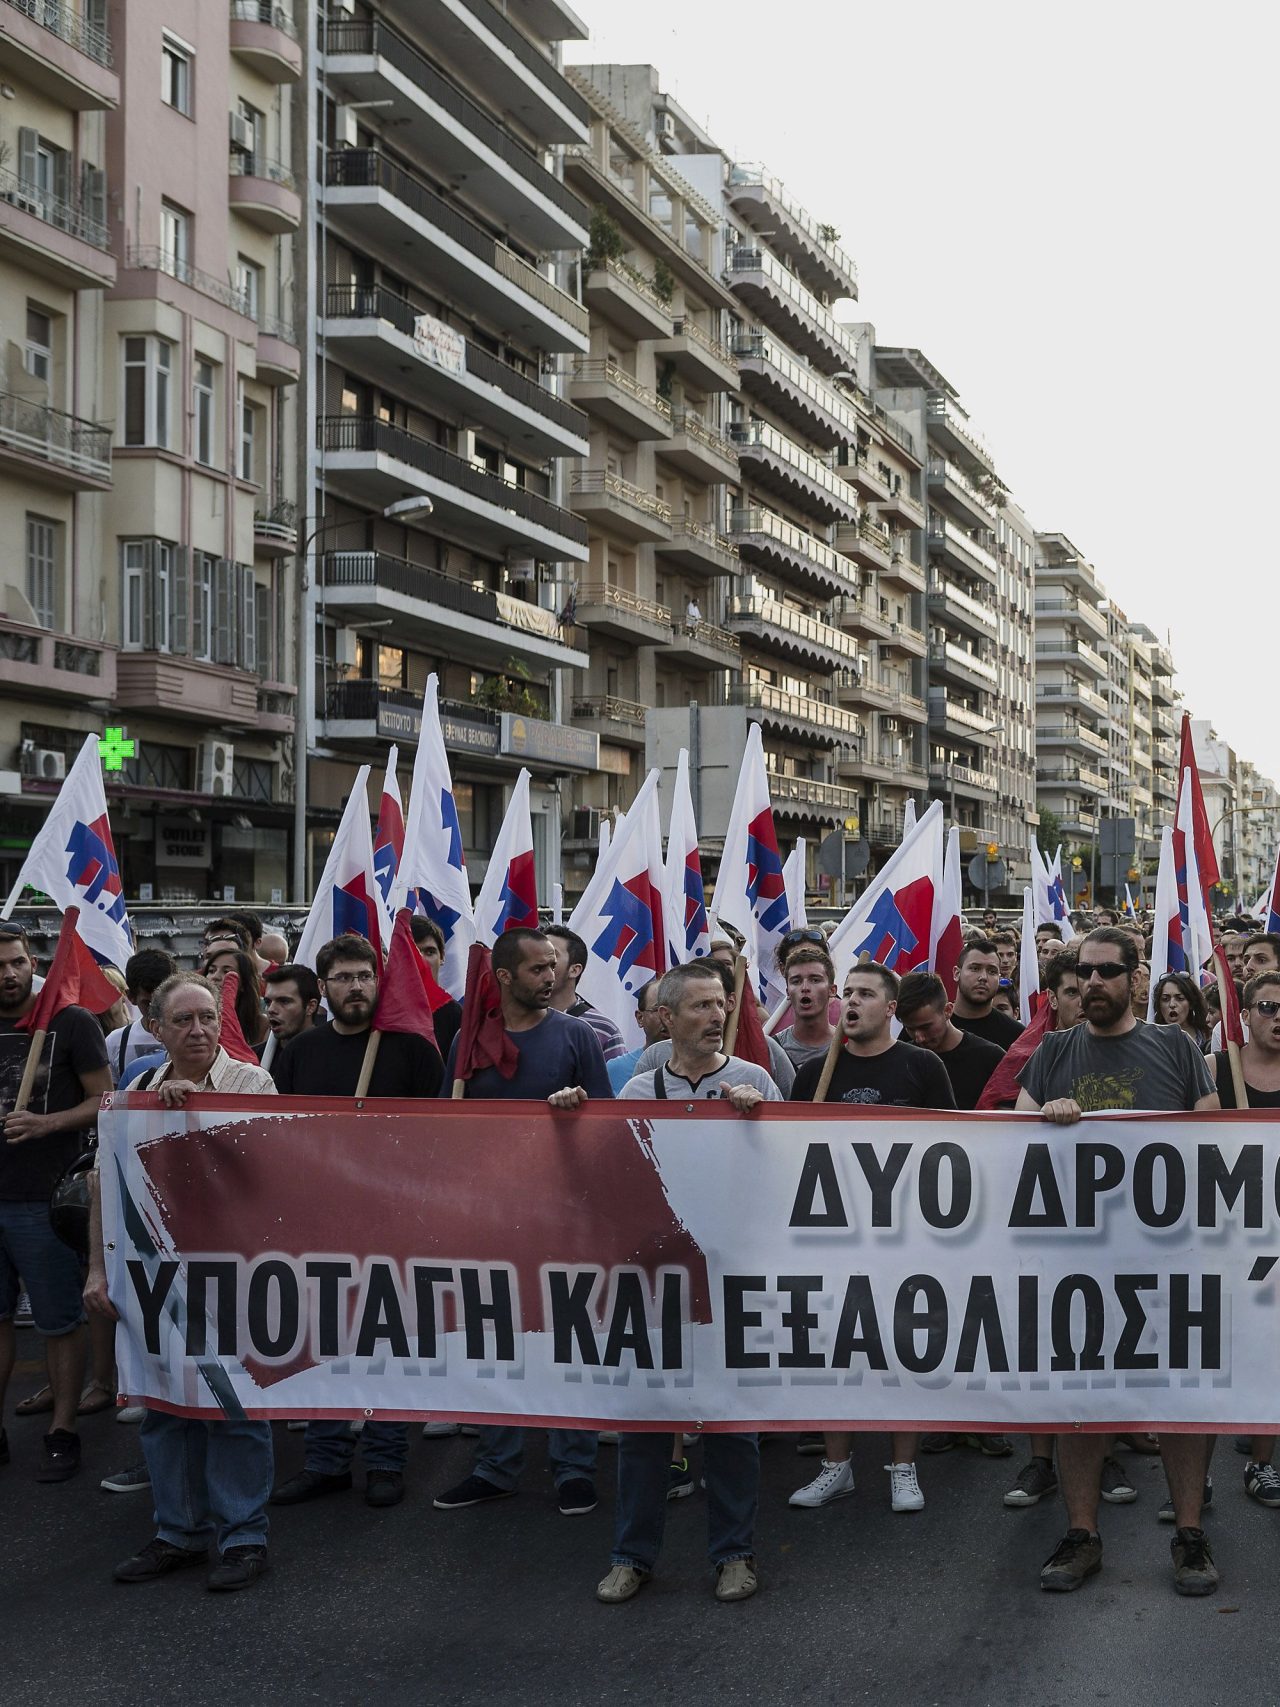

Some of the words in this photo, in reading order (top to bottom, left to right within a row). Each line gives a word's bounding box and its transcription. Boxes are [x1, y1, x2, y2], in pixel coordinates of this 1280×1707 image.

[162, 827, 206, 842] OUTLET
[166, 844, 205, 857] STORE
[788, 1141, 972, 1230] ΔΥΟ
[126, 1259, 516, 1362] ΥΠΟΤΑΓΗ
[547, 1269, 683, 1371] ΚΑΙ
[722, 1272, 1222, 1374] ΕΞΑΘΛΙΩΣΗ
